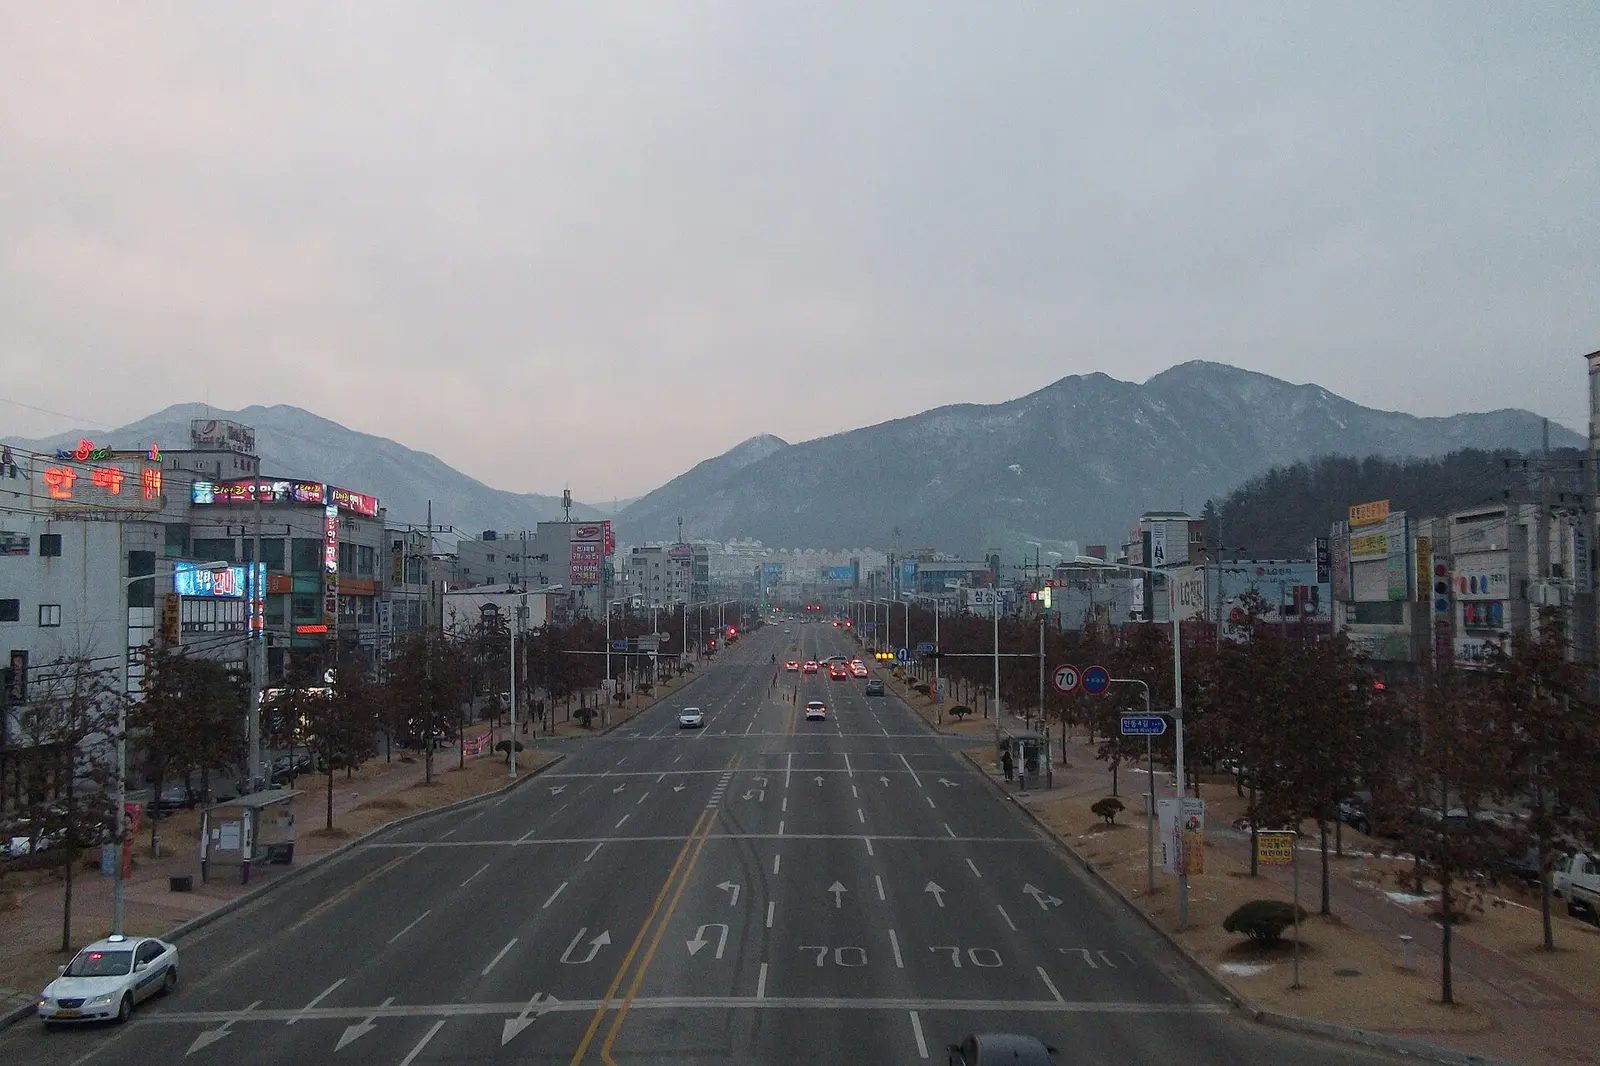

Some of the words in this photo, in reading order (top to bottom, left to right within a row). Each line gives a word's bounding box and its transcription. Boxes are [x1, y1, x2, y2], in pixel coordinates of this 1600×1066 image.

[212, 568, 235, 595] 안마
[1058, 672, 1074, 686] 70
[797, 946, 868, 968] 70
[928, 945, 1004, 968] 70
